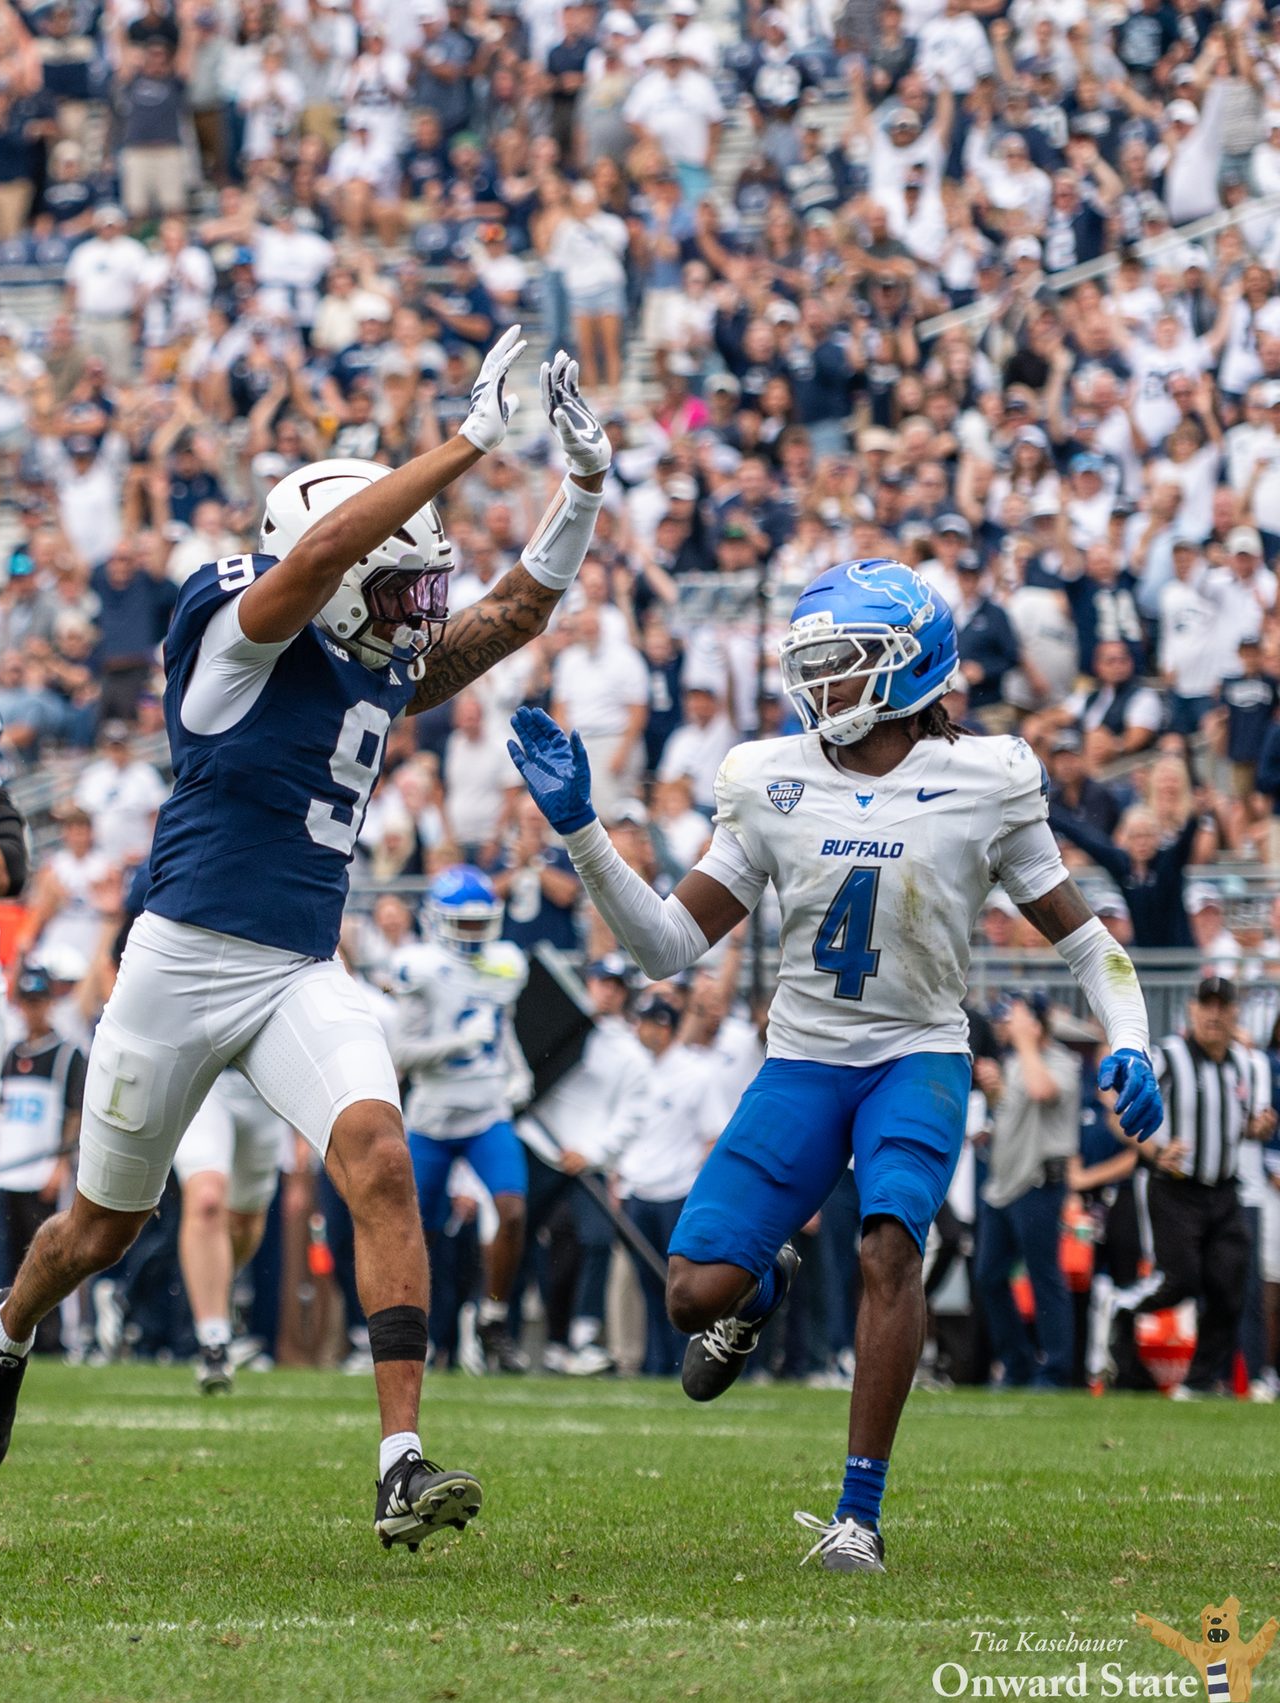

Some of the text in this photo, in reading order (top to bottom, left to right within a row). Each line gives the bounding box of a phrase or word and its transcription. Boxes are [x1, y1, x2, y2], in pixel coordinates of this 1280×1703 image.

[217, 554, 254, 592] 9
[305, 700, 391, 856] 9
[770, 790, 801, 800] MAC
[821, 839, 903, 859] BUFFALO
[813, 866, 881, 1001] 4
